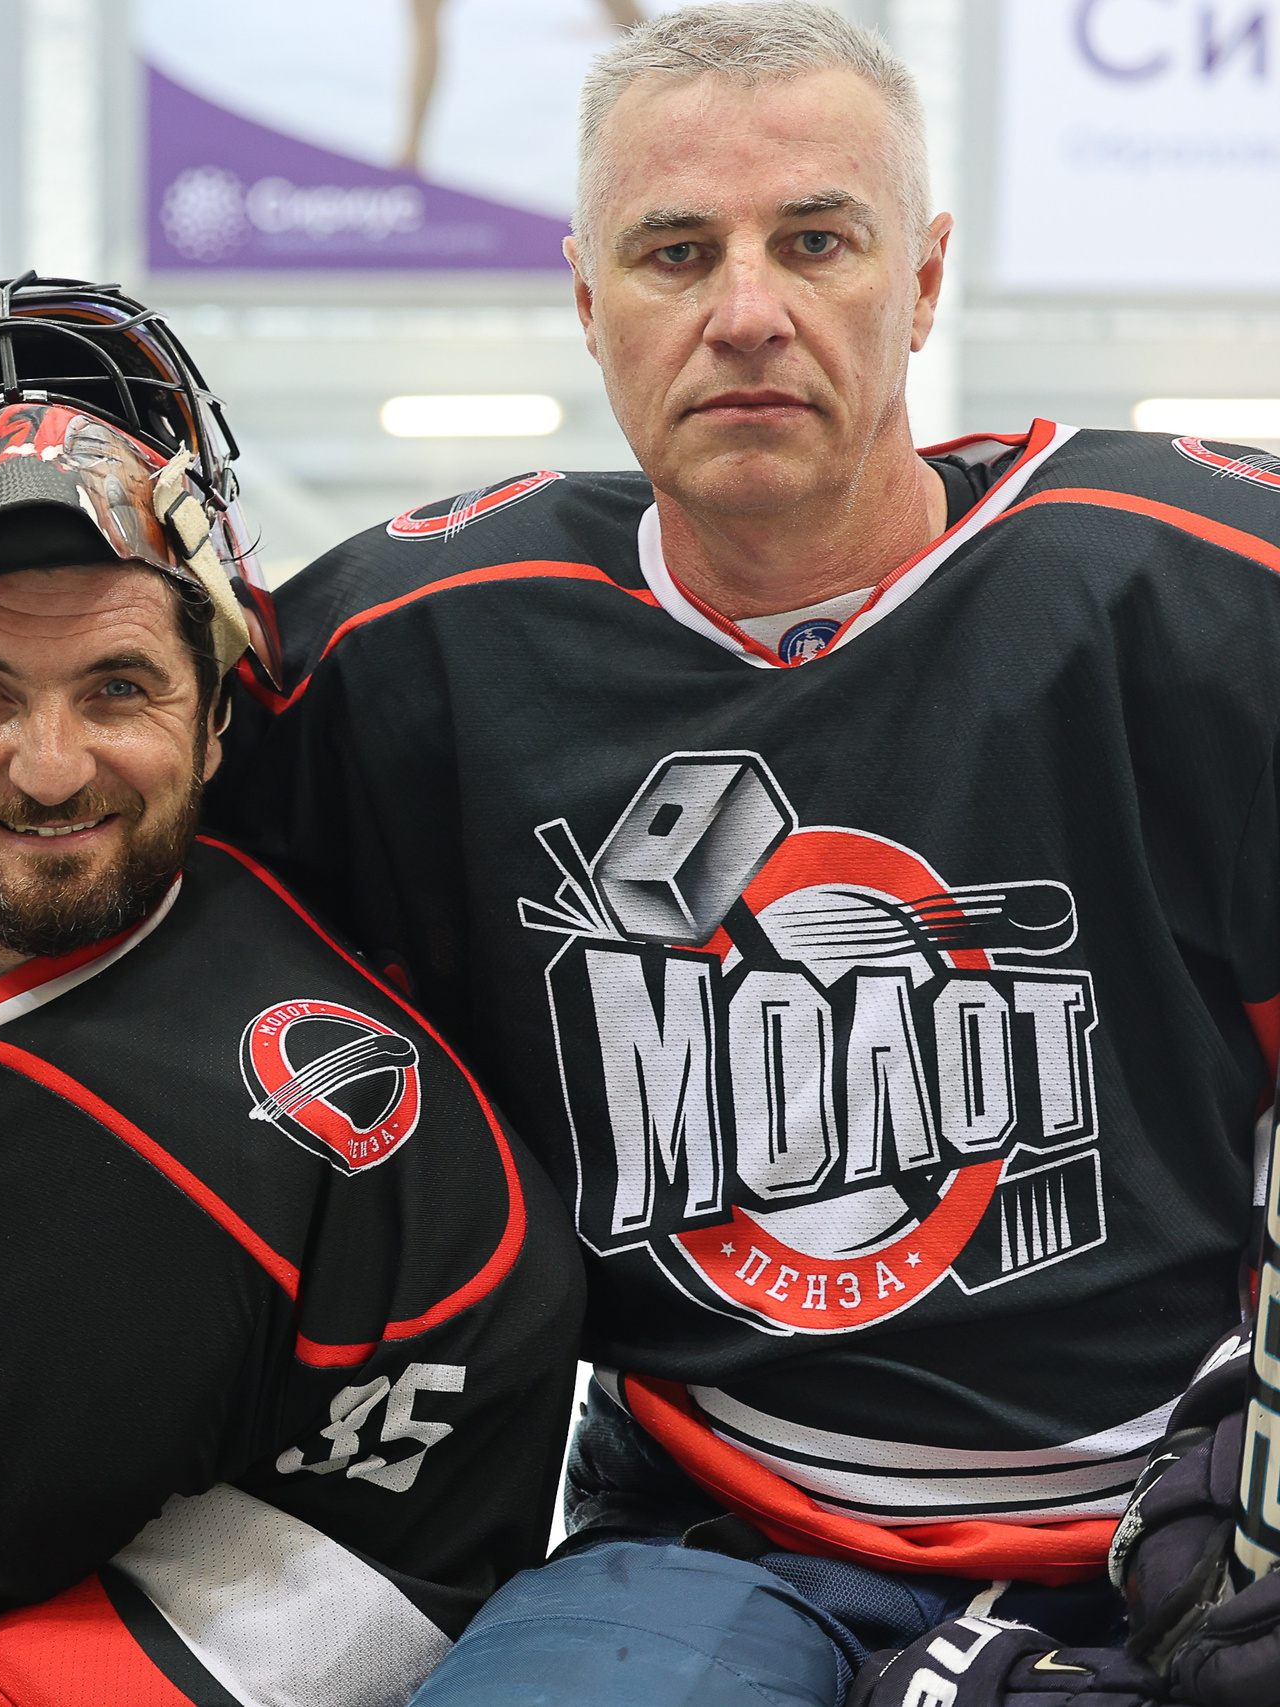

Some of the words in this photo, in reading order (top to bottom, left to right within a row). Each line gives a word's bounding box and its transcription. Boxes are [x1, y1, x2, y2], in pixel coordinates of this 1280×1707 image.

[258, 1003, 311, 1036] МОЛОТ
[585, 948, 1087, 1236] МОЛОТ
[734, 1244, 906, 1311] ПЕНЗА
